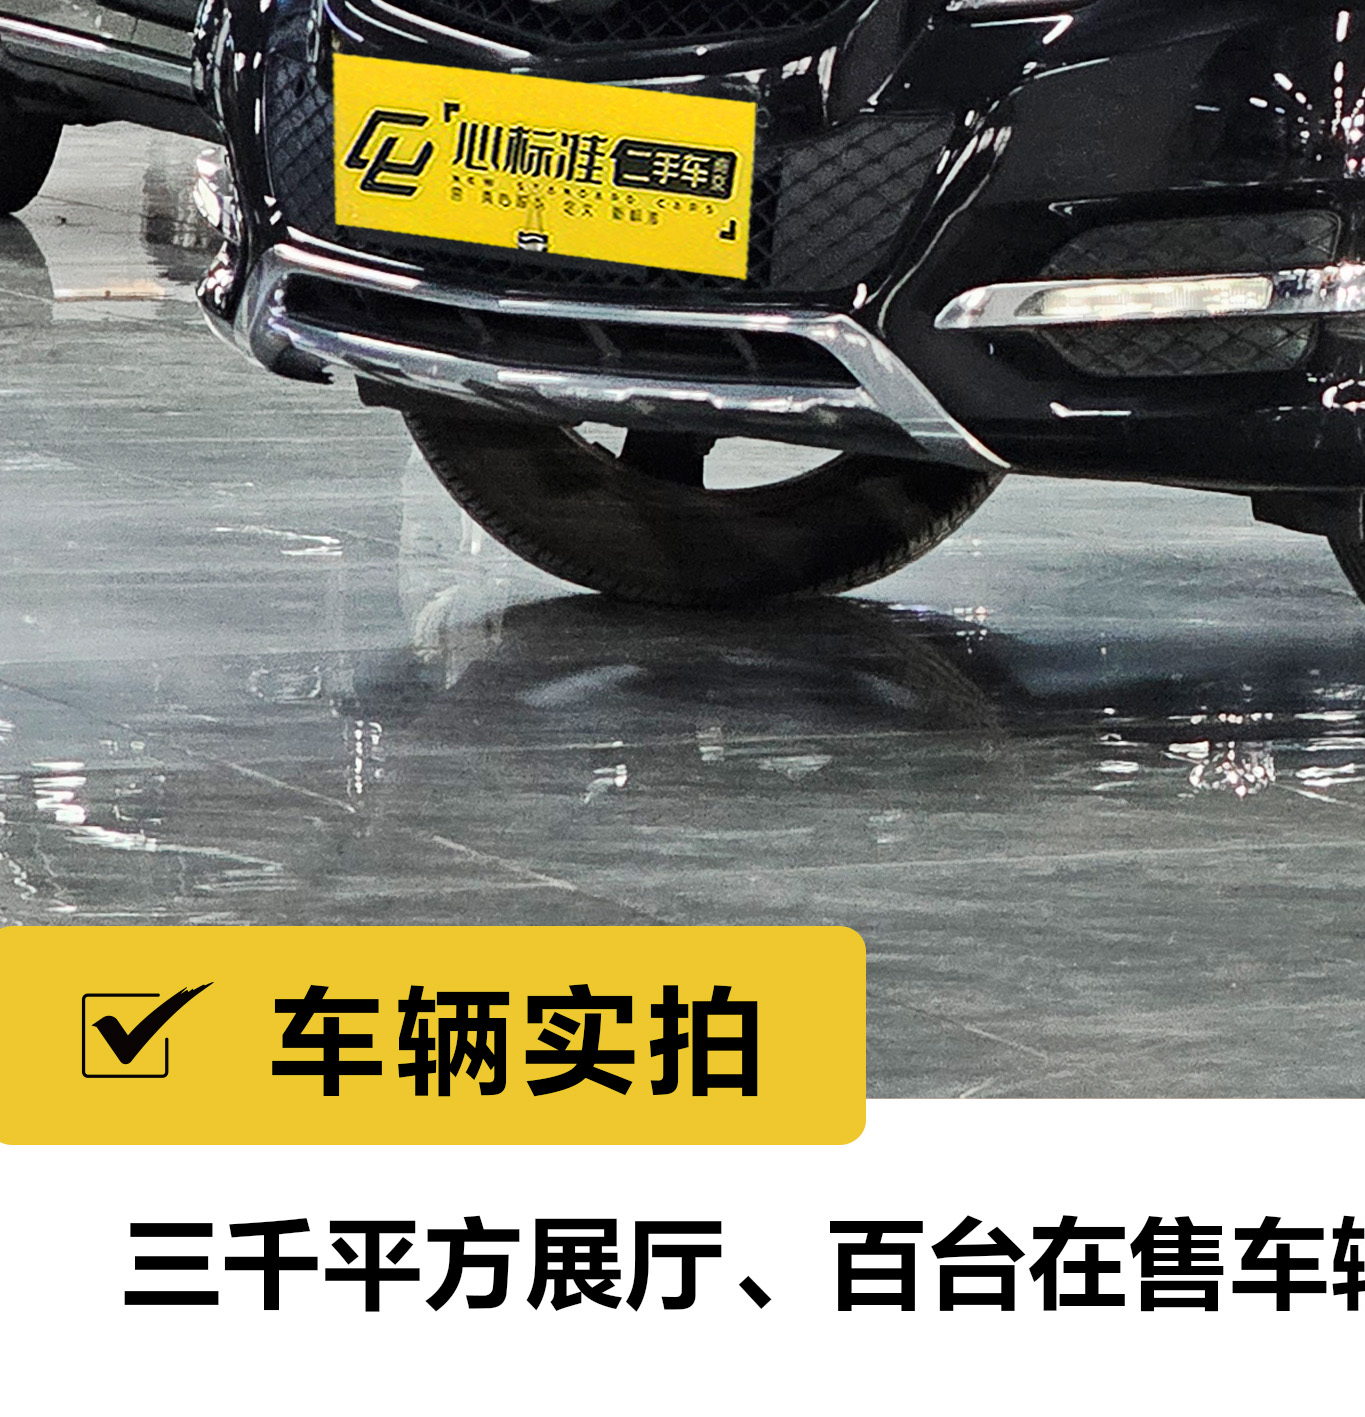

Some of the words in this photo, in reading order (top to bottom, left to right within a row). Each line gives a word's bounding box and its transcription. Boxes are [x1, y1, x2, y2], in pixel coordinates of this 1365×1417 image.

[452, 122, 608, 187] 心标准
[622, 148, 712, 190] 二手车
